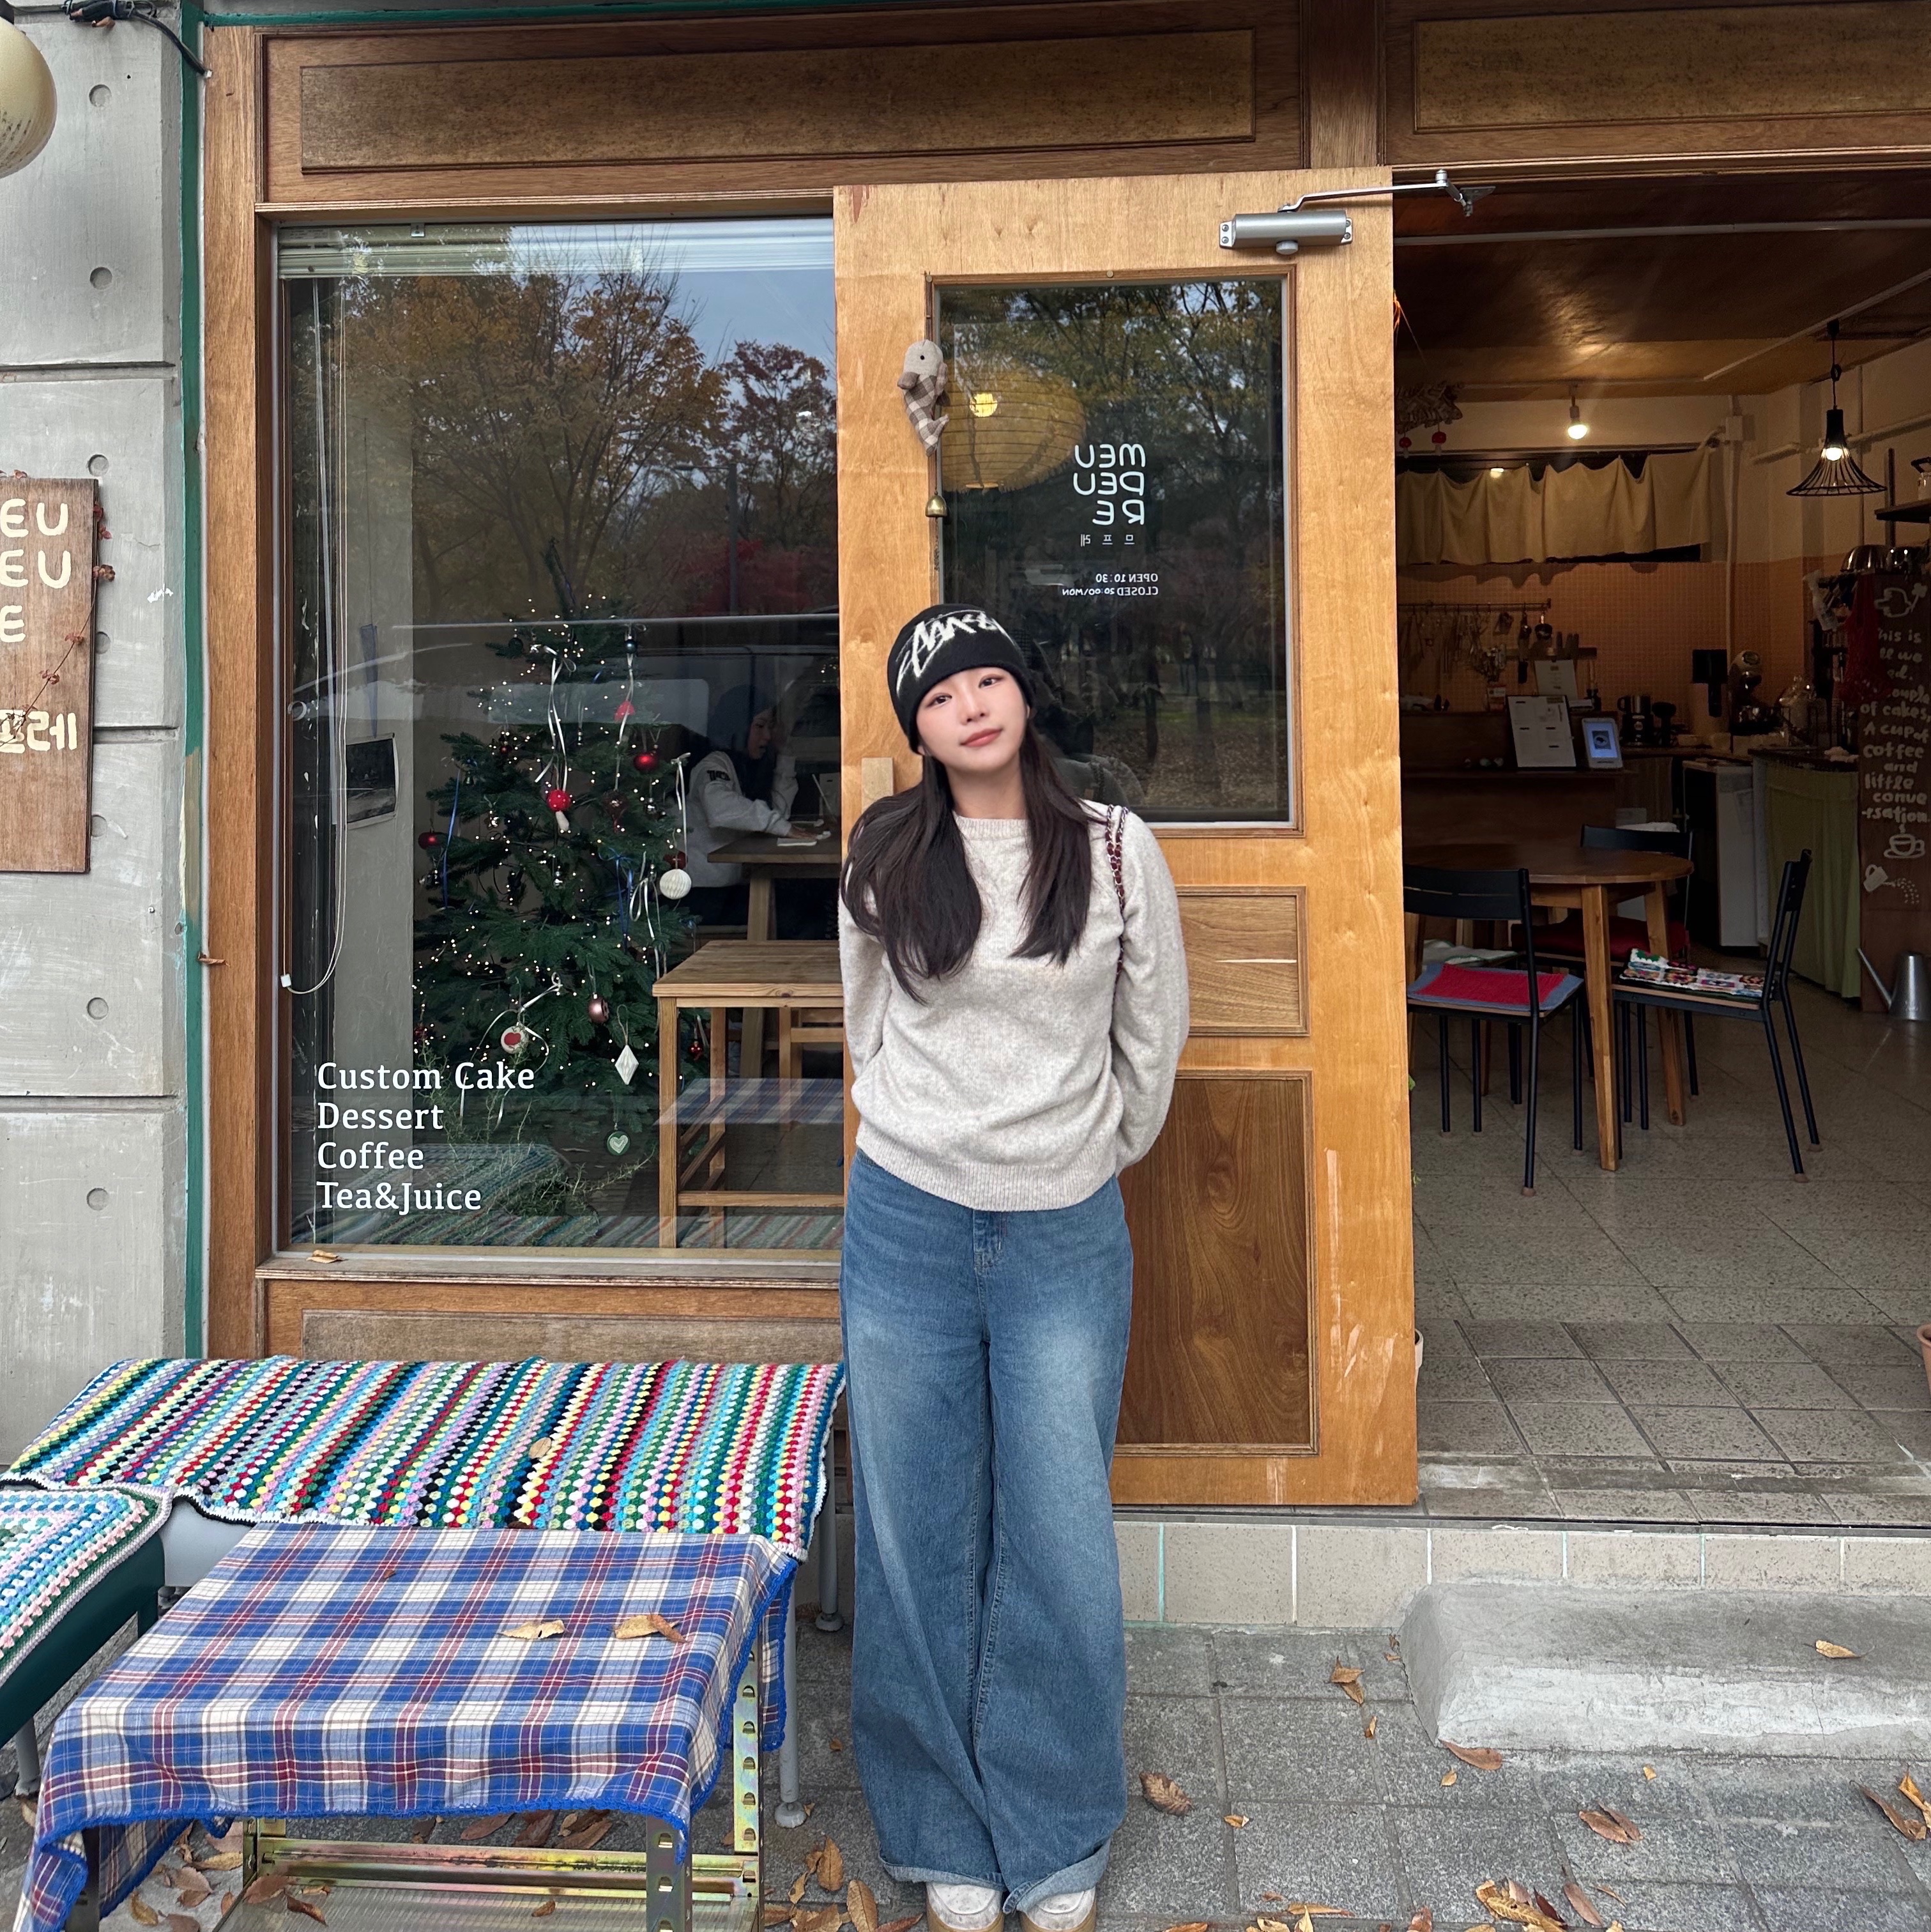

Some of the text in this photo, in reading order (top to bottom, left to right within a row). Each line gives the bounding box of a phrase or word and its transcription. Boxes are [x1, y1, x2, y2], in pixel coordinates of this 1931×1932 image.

[1878, 627, 1923, 644] his is
[1897, 650, 1923, 663] we
[1859, 700, 1878, 717] of
[1863, 721, 1930, 744] A cup of
[1883, 760, 1918, 774] and
[1864, 771, 1914, 791] little
[317, 1061, 535, 1090] Custom Cake
[317, 1102, 444, 1130] Dessert
[317, 1141, 424, 1169] Coffee
[316, 1181, 482, 1215] Tea&Juice
